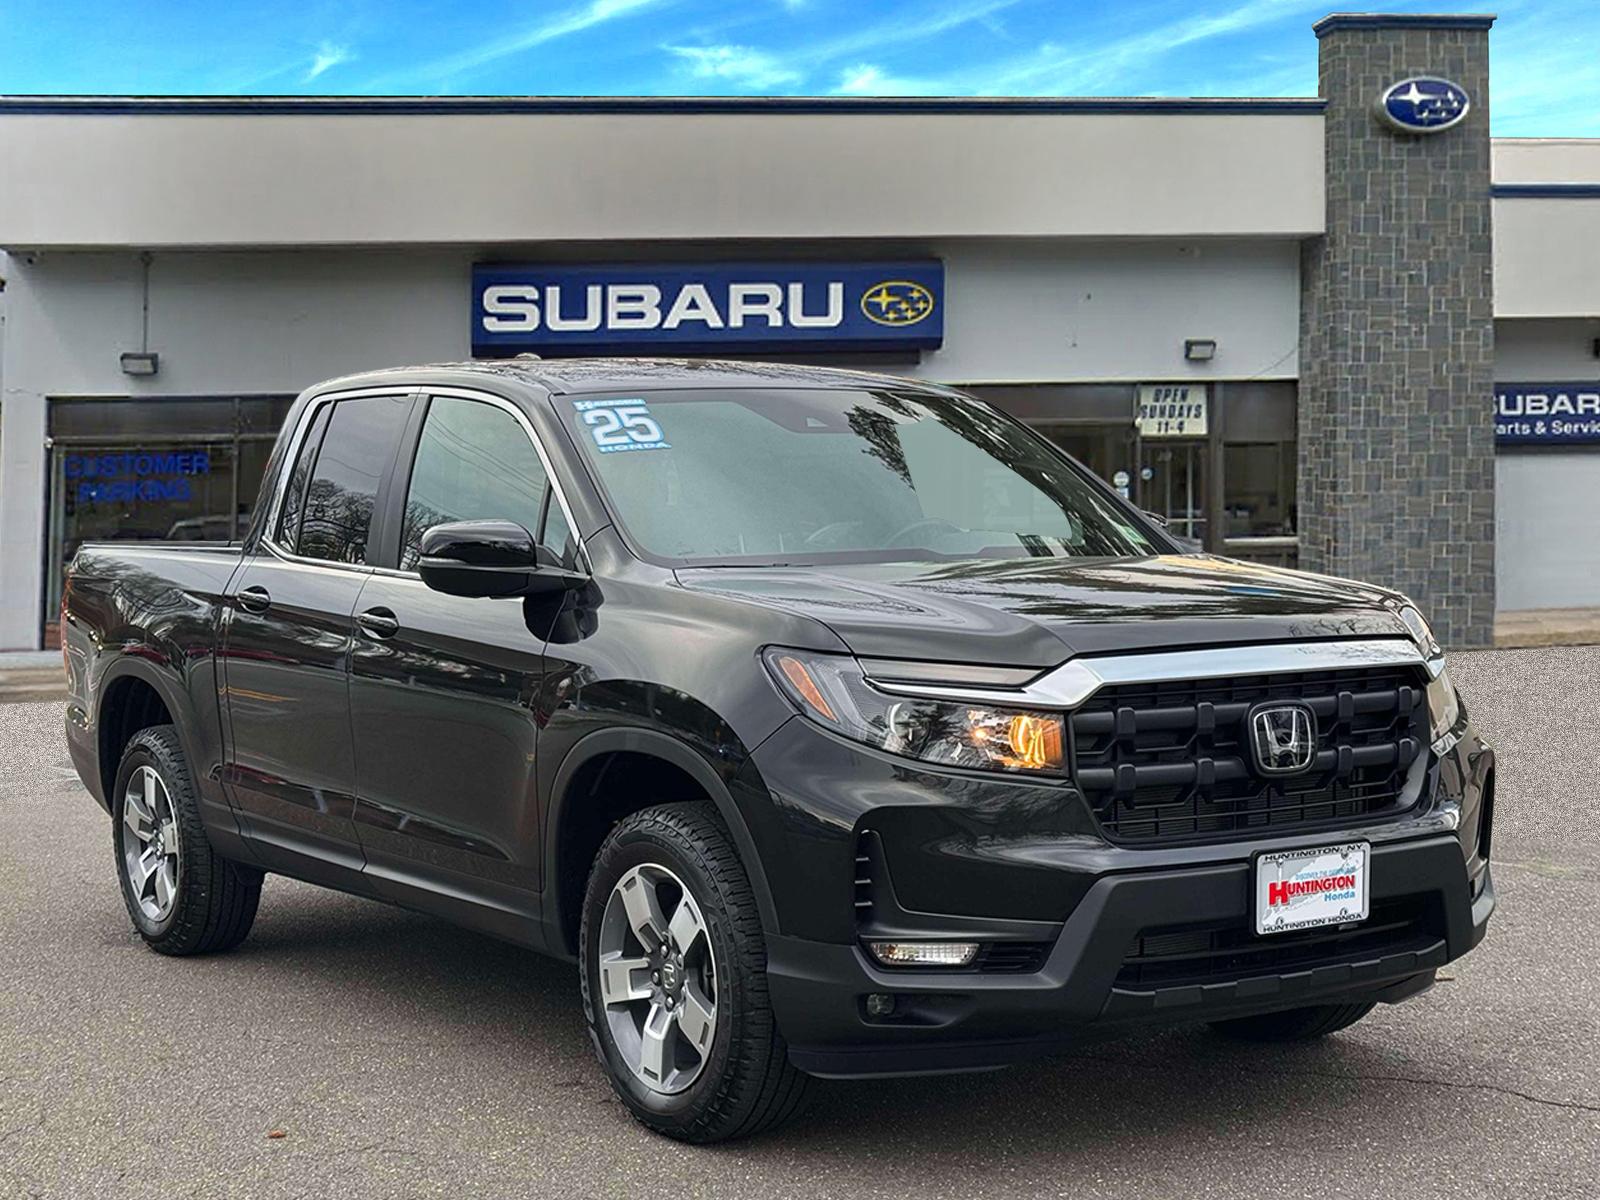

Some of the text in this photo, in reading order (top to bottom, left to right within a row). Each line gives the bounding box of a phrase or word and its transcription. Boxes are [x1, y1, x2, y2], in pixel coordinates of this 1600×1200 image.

[482, 282, 844, 332] SUBARU
[1153, 388, 1189, 402] OPEN
[1493, 393, 1600, 416] UBAR
[1140, 404, 1202, 419] SUNDAYS
[582, 406, 664, 446] 25
[1534, 421, 1546, 434] &
[65, 453, 209, 477] CUSTOMER
[78, 479, 190, 503] PARKING
[1347, 843, 1363, 852] NY
[1324, 890, 1355, 901] Honda
[1263, 913, 1362, 933] HUNTINGTON HONDA
